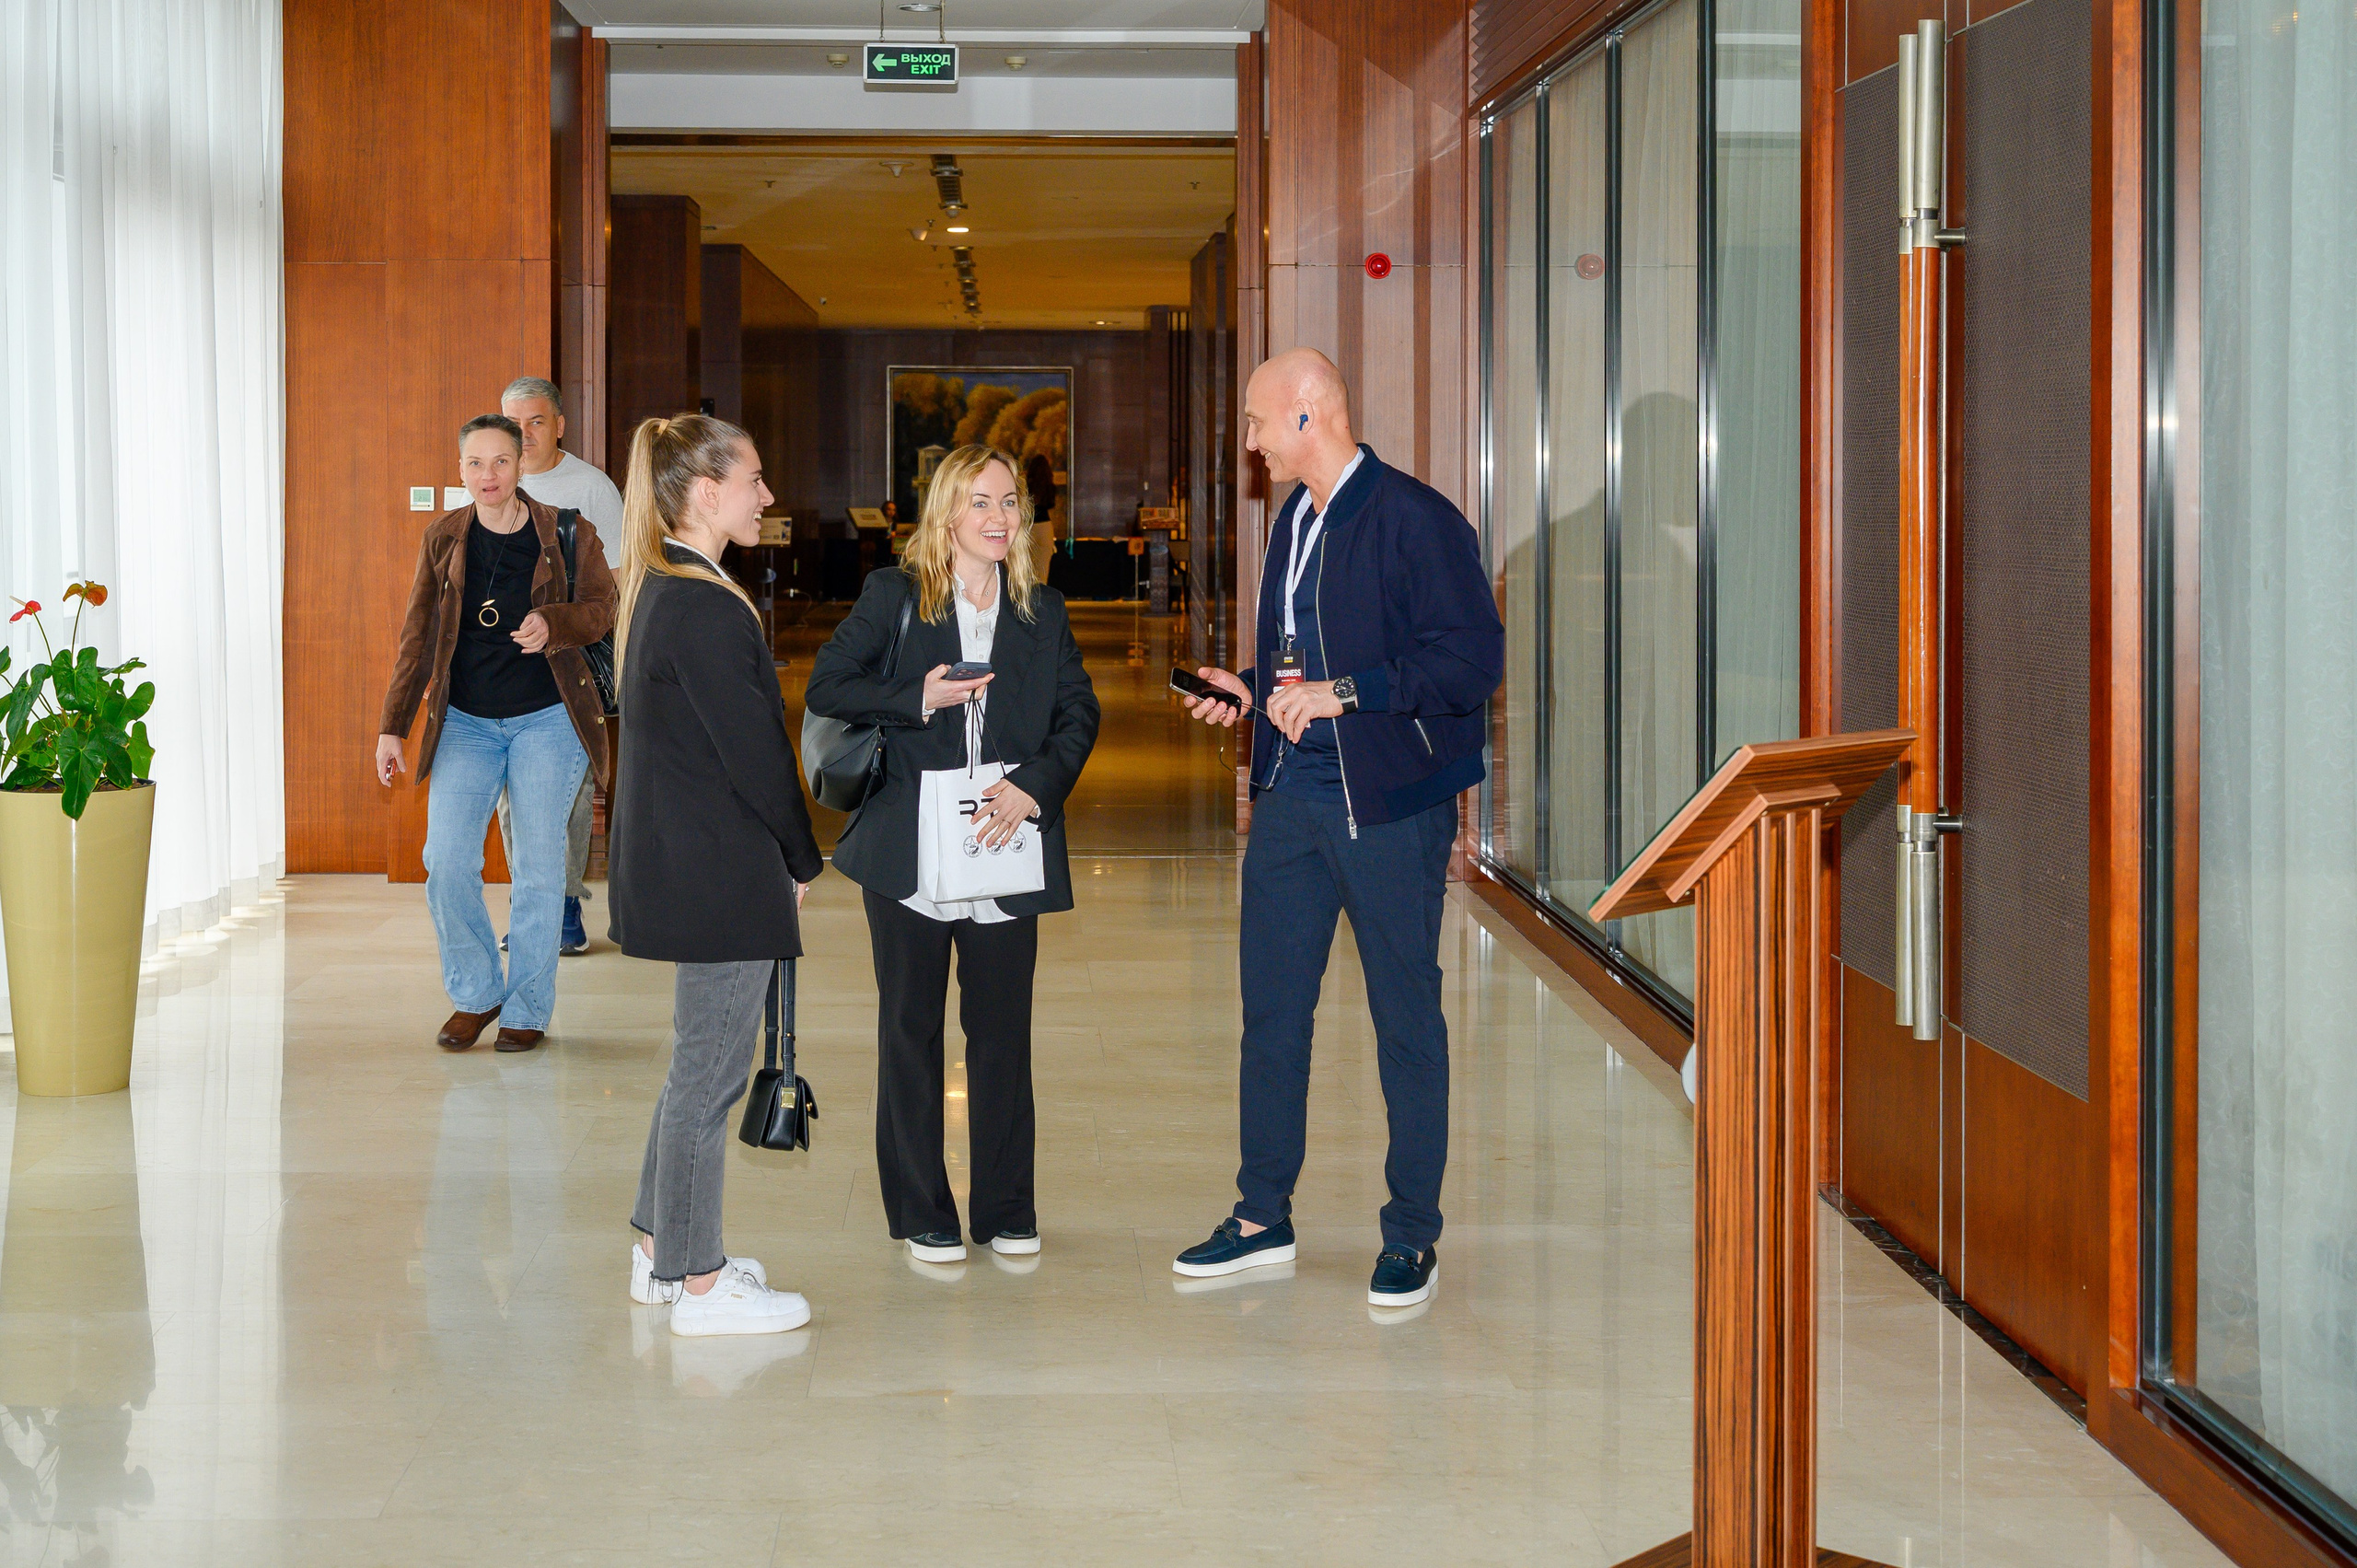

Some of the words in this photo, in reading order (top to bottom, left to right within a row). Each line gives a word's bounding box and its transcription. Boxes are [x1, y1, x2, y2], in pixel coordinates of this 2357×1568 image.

[900, 52, 951, 66] ВЫХОД
[911, 64, 942, 75] EXIT
[1276, 668, 1302, 678] BUSINESS
